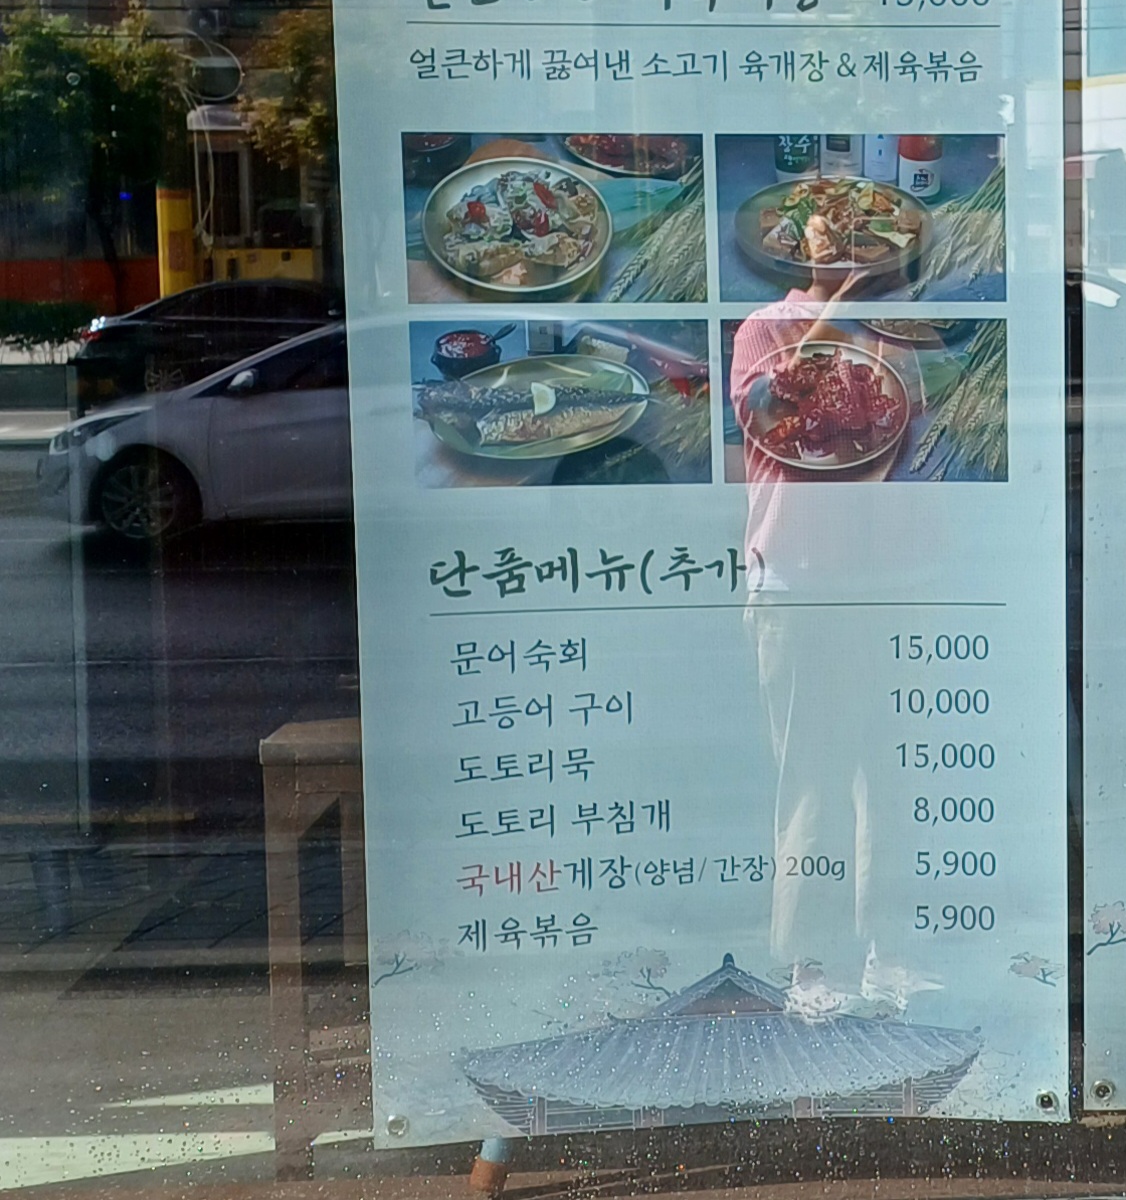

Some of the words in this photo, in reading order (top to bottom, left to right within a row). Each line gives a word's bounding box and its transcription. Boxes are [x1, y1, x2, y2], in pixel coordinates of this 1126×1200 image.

[409, 48, 531, 80] 얼큰하게
[542, 49, 634, 82] 끓여낸
[642, 49, 729, 81] 소고기
[739, 50, 828, 82] 육개장
[862, 50, 983, 84] 제육볶음
[429, 545, 766, 599] 단품메뉴(추가)
[450, 638, 589, 676] 문어숙회
[889, 632, 990, 665] 15,000
[452, 691, 555, 730] 고등어
[569, 690, 634, 726] 구이
[889, 688, 990, 719] 10,000
[454, 745, 596, 786] 도토리묵
[896, 741, 996, 774] 15,000
[455, 801, 556, 841] 도토리
[572, 799, 672, 836] 부침개
[913, 796, 994, 828] 8,000
[785, 854, 846, 881] 200g
[914, 850, 996, 882] 5,900
[458, 912, 599, 952] 제육볶음
[914, 905, 996, 936] 5,900
